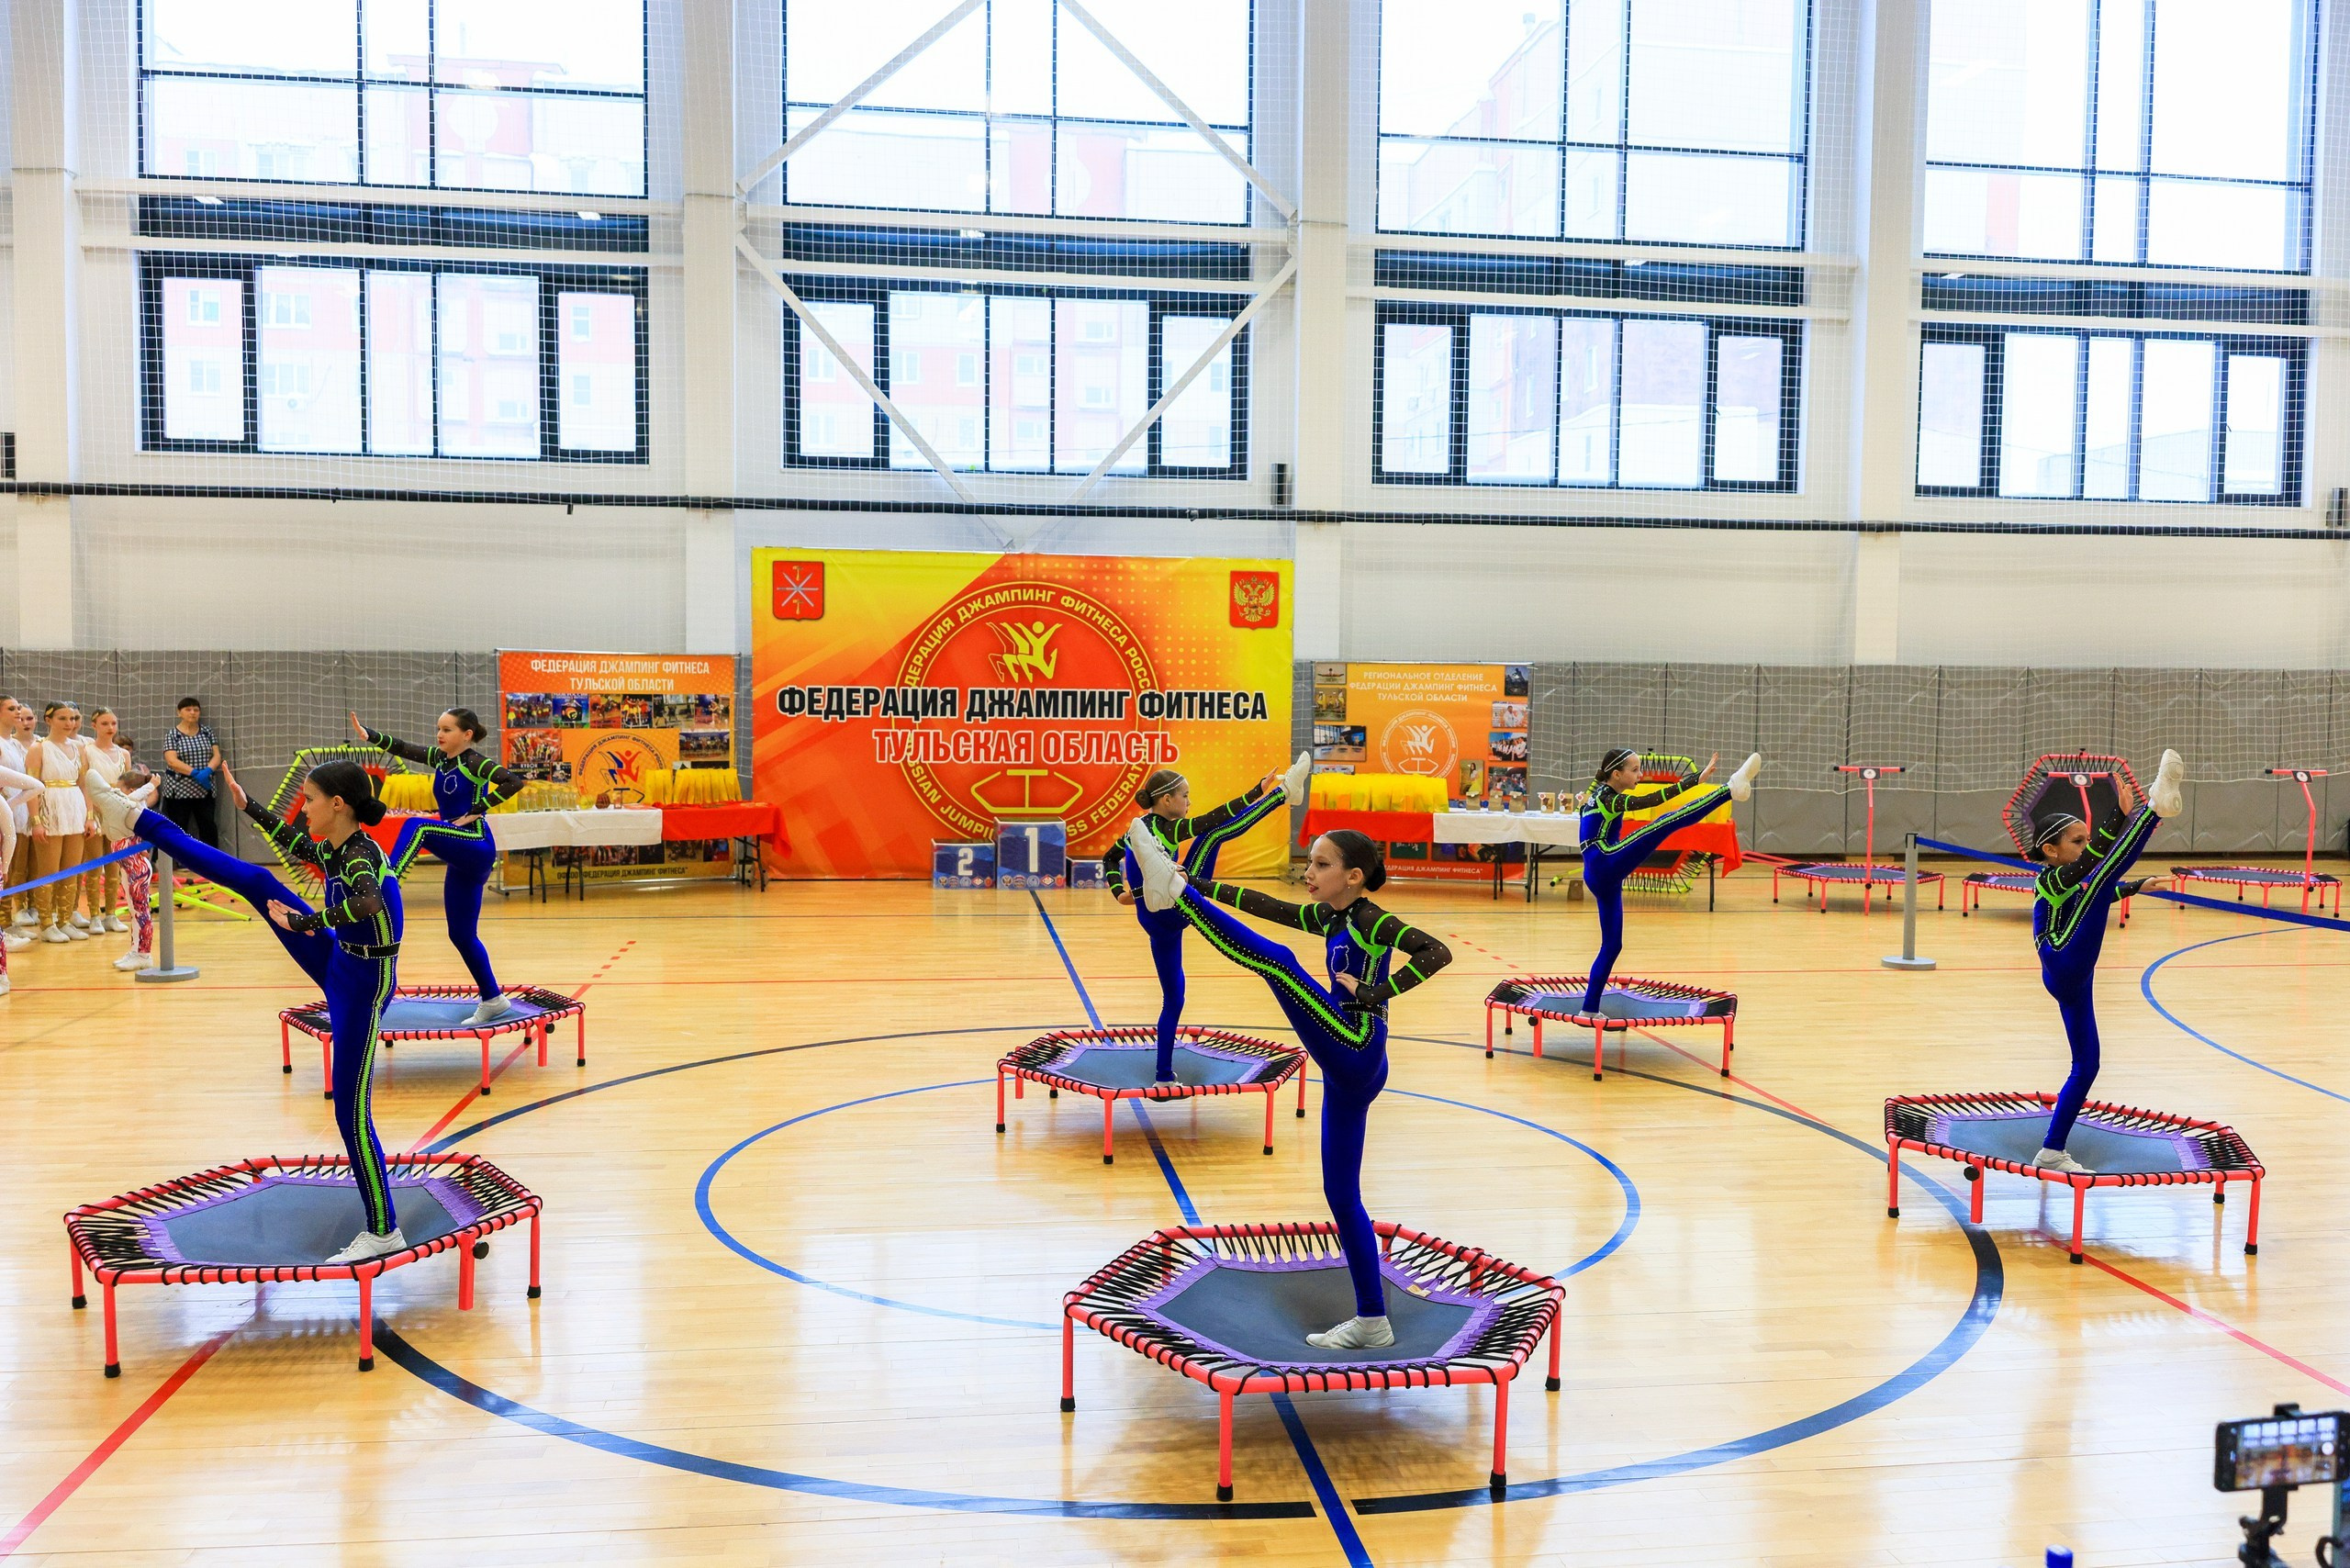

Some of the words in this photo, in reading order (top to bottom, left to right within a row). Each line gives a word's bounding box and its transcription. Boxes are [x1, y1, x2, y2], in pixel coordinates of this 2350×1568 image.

[903, 617, 956, 689] ДЕРАЦИЯ
[956, 588, 1056, 623] ДЖАМПИНГ
[1060, 595, 1128, 647] ФИТНЕСА
[1125, 646, 1151, 690] РОСС
[530, 659, 597, 673] ФЕДЕРАЦИЯ
[599, 660, 660, 675] ДЖАМПИНГ
[662, 661, 710, 674] ФИТНЕСА
[1363, 671, 1431, 680] РЕГИОНАЛЬНОЕ
[1433, 672, 1484, 681] ОТДЕЛЕНИЕ
[569, 676, 625, 690] ТУЛЬСКОЙ
[627, 678, 674, 691] ОБЛАСТИ
[1348, 682, 1402, 690] ФЕДЕРАЦИИ
[1403, 683, 1454, 691] ДЖАМПИНГ
[1456, 684, 1498, 692] ФИТНЕСА
[777, 686, 958, 722] ФЕДЕРАЦИЯ
[964, 687, 1131, 723] ДЖАМПИНГ
[1136, 690, 1269, 721] ФИТНЕСА
[1377, 691, 1424, 701] ТУЛЬСКОЙ
[1426, 693, 1468, 702] ОБЛАСТИ
[872, 729, 1034, 765] ТУЛЬСКАЯ
[1040, 730, 1180, 765] ОБЛАСТЬ
[939, 804, 994, 839] JUMPI
[1024, 827, 1039, 873] 1
[957, 847, 974, 876] 2
[1094, 863, 1104, 879] 3
